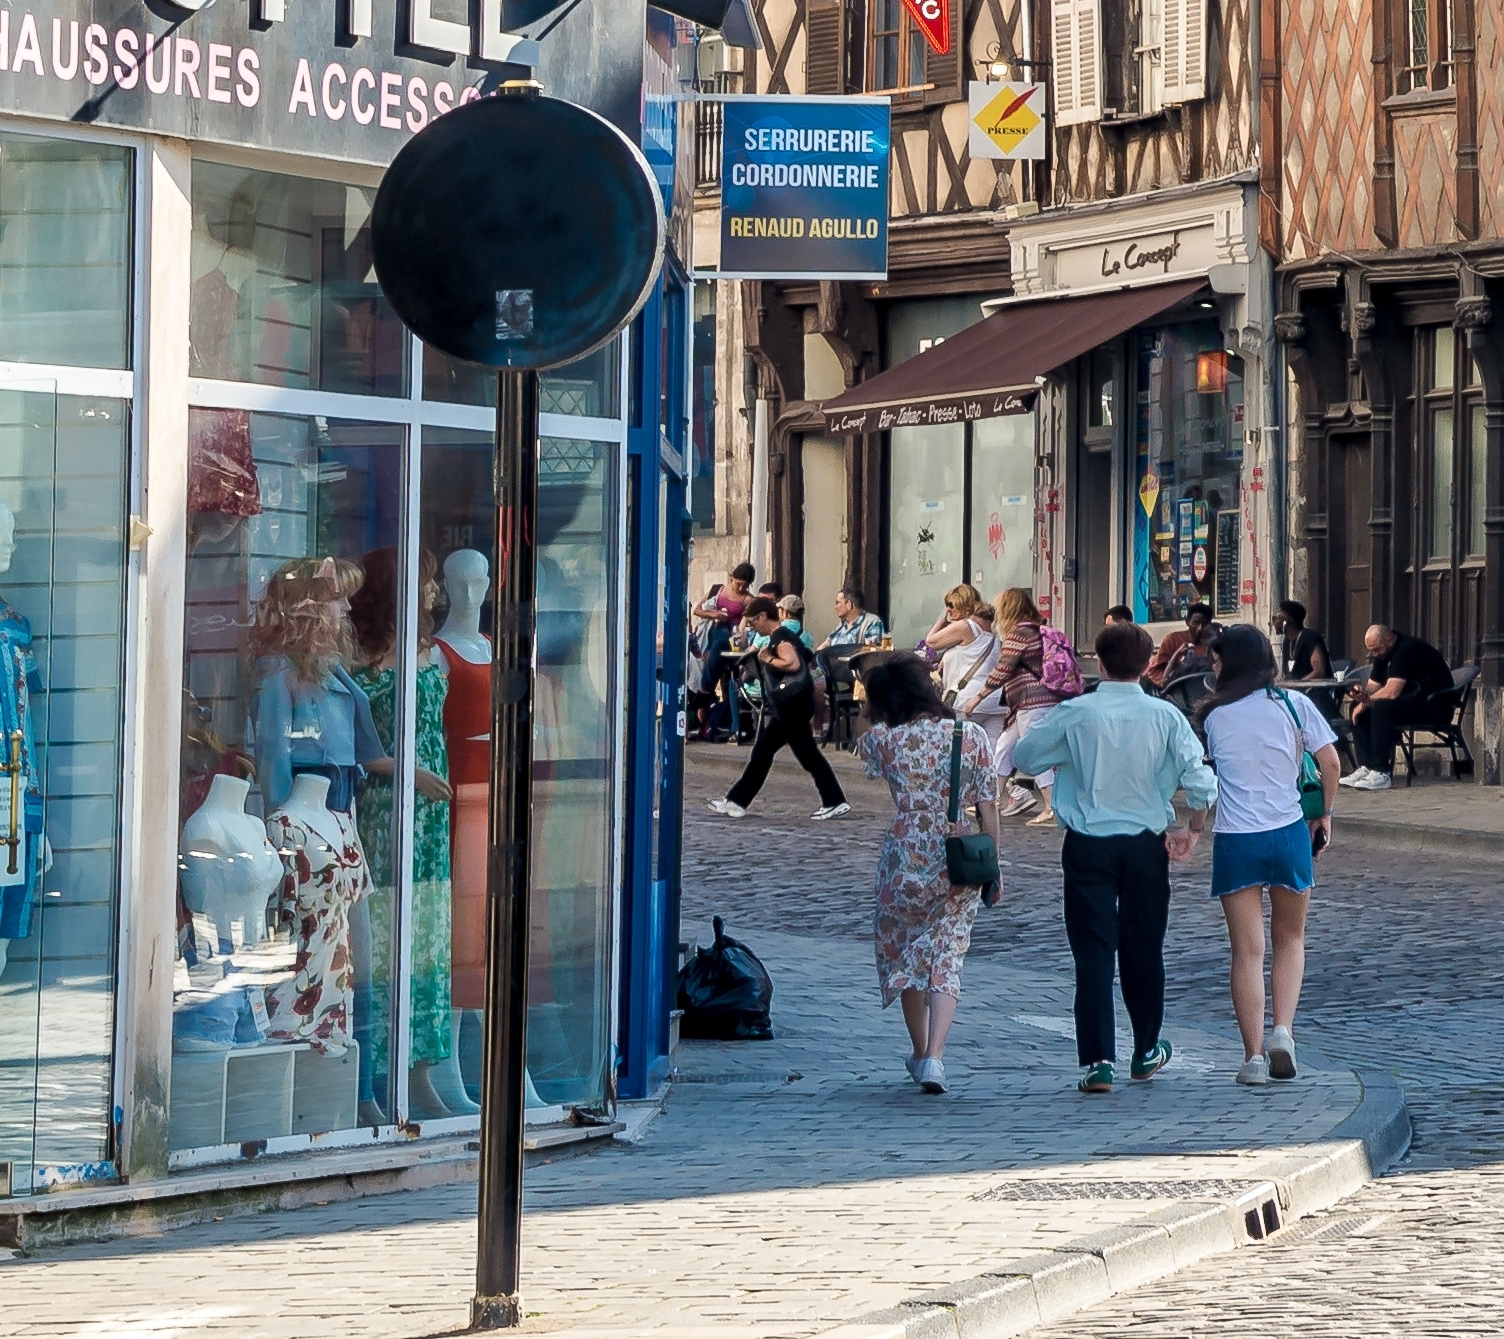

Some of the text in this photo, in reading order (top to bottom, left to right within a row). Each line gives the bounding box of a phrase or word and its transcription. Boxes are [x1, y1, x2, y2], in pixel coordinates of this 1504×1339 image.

[744, 128, 874, 153] SERRURERIE
[986, 126, 1029, 136] PRESSE
[732, 163, 879, 188] CORDONNERIE
[730, 217, 879, 239] RENAUD AGULLO
[1101, 231, 1181, 277] Le Concept
